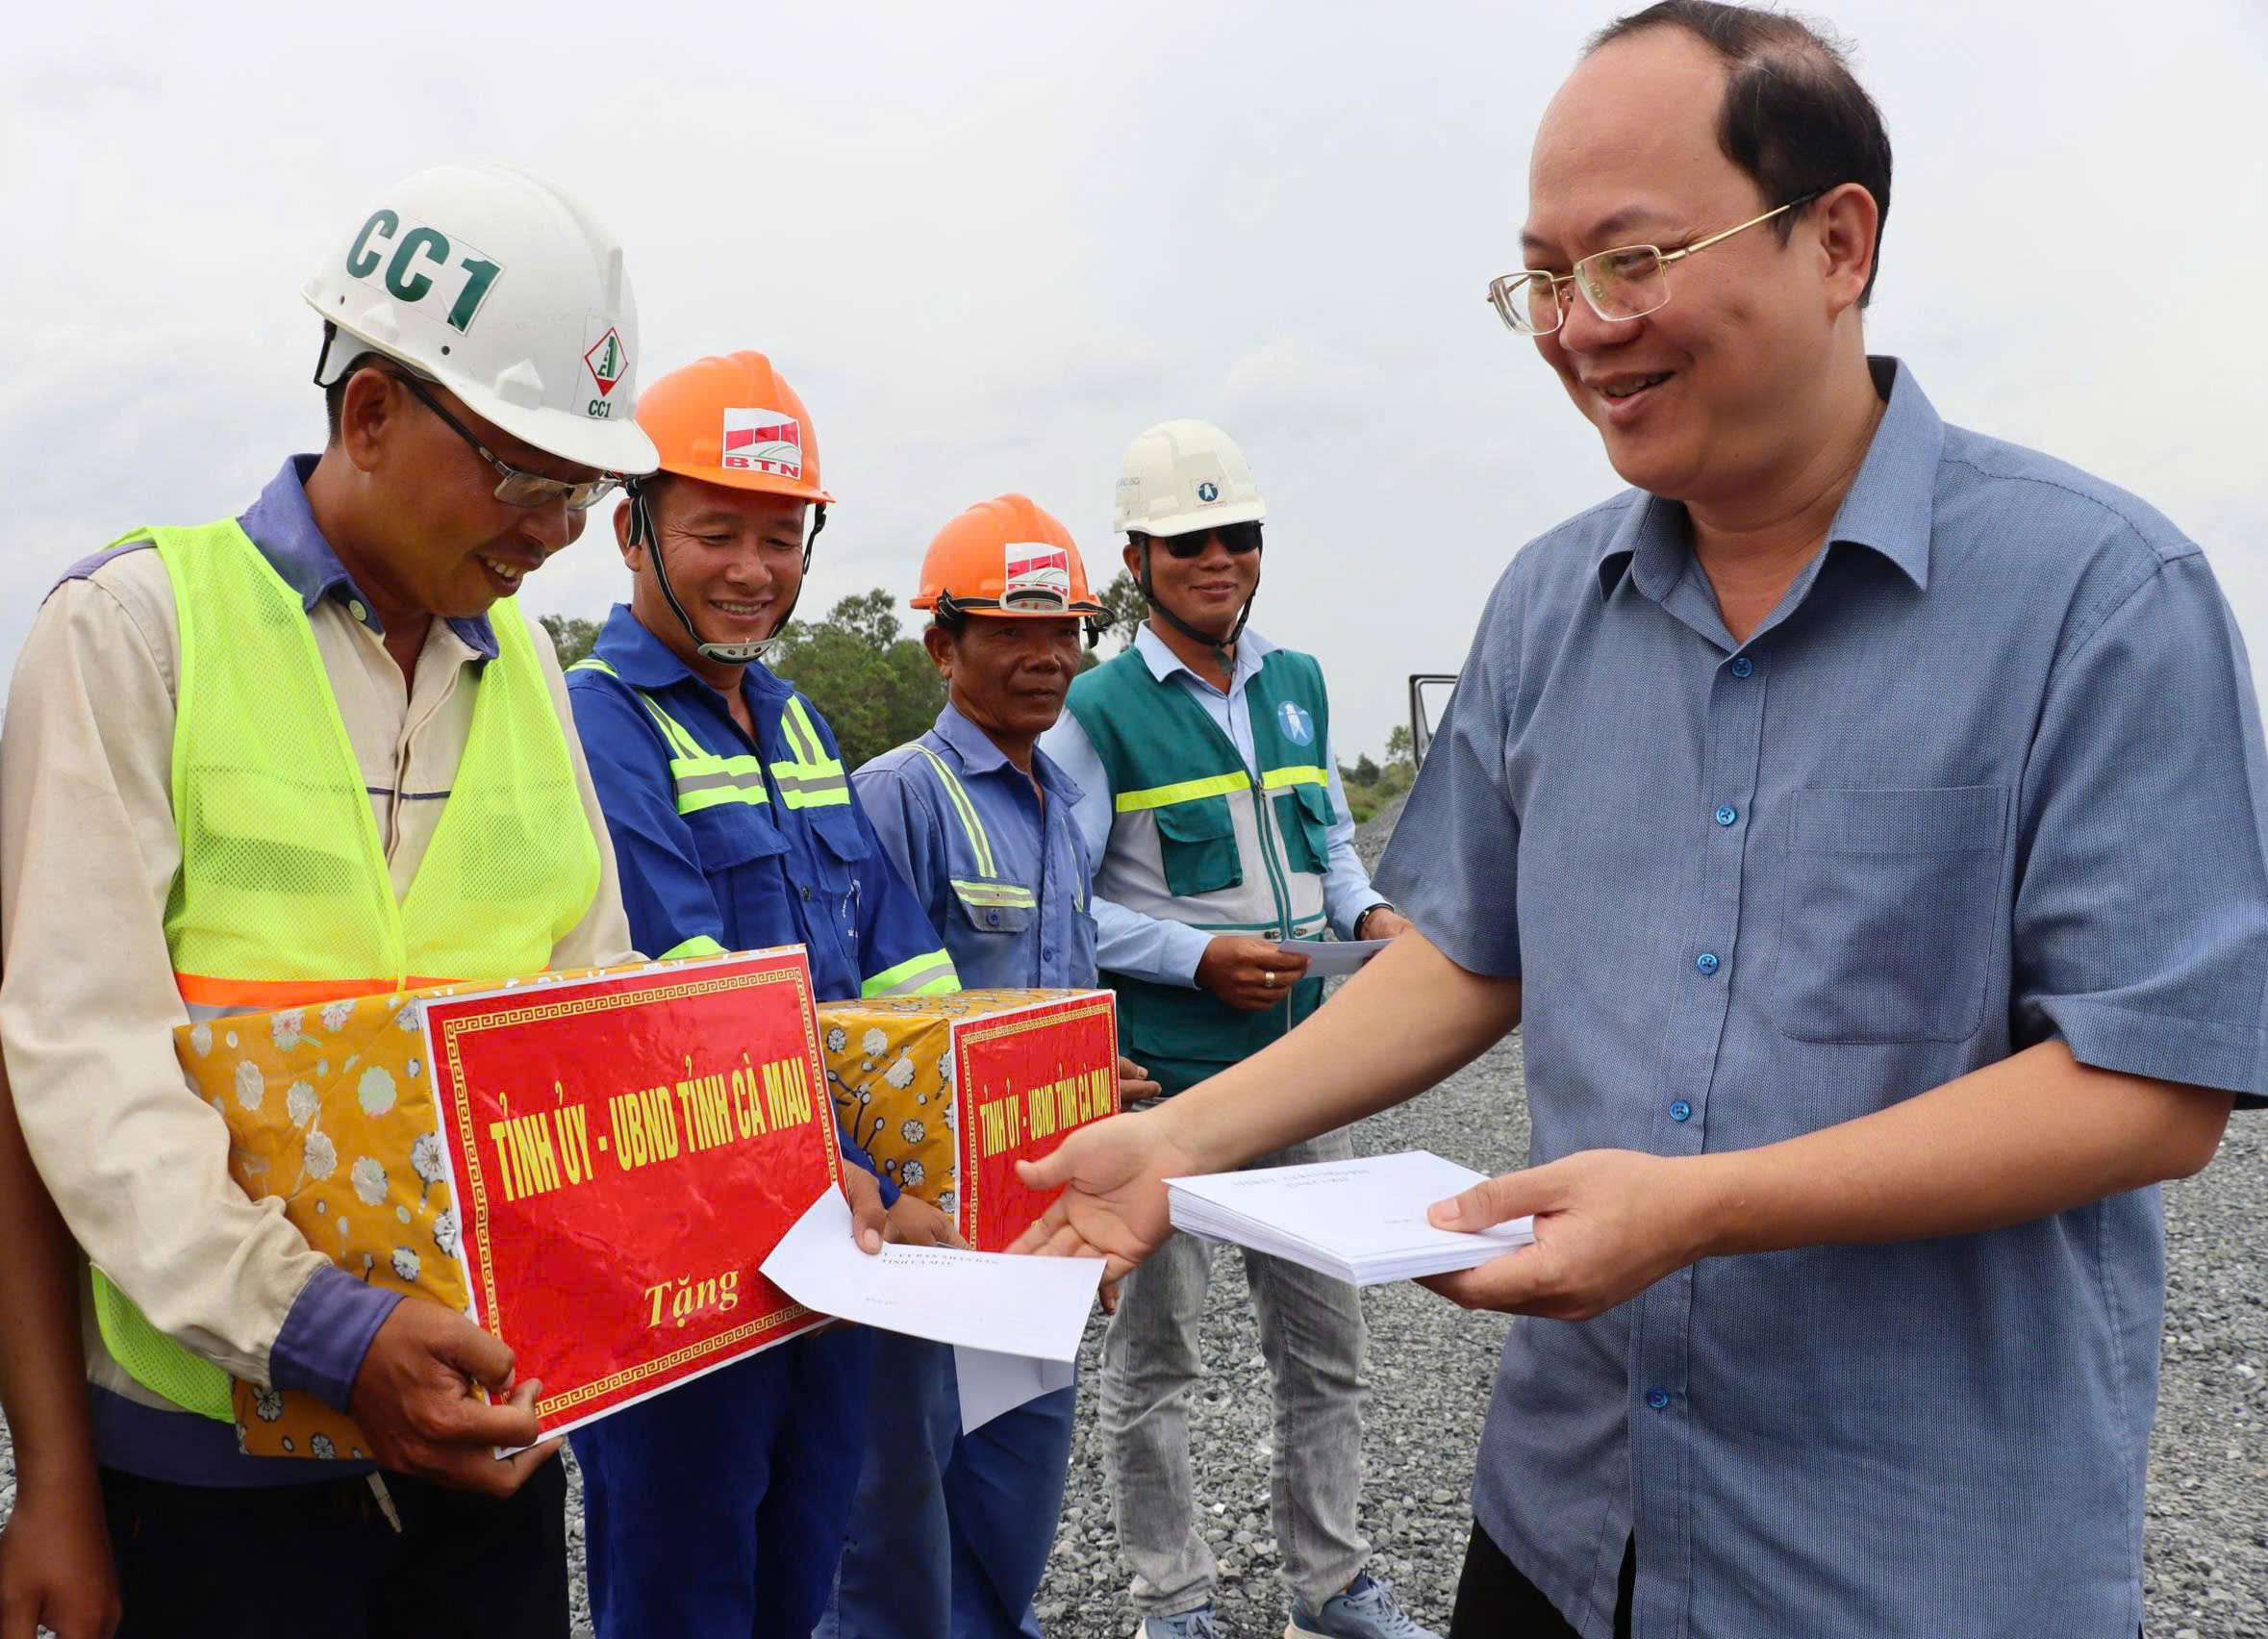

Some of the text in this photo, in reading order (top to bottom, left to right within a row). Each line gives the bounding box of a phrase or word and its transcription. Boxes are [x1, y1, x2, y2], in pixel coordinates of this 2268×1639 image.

[346, 209, 502, 334] CC1
[588, 399, 612, 418] CC1
[725, 456, 799, 478] BTN
[489, 1052, 812, 1201] TỈNH ỦY - UBND TỈNH CÀ MAU
[979, 1084, 1007, 1159] TỈNH
[1005, 1076, 1021, 1149] ỦY
[1028, 1084, 1056, 1142] UBND
[1055, 1062, 1078, 1131] TỈNH
[1091, 1066, 1111, 1119] MAU
[644, 1271, 740, 1328] Tặng
